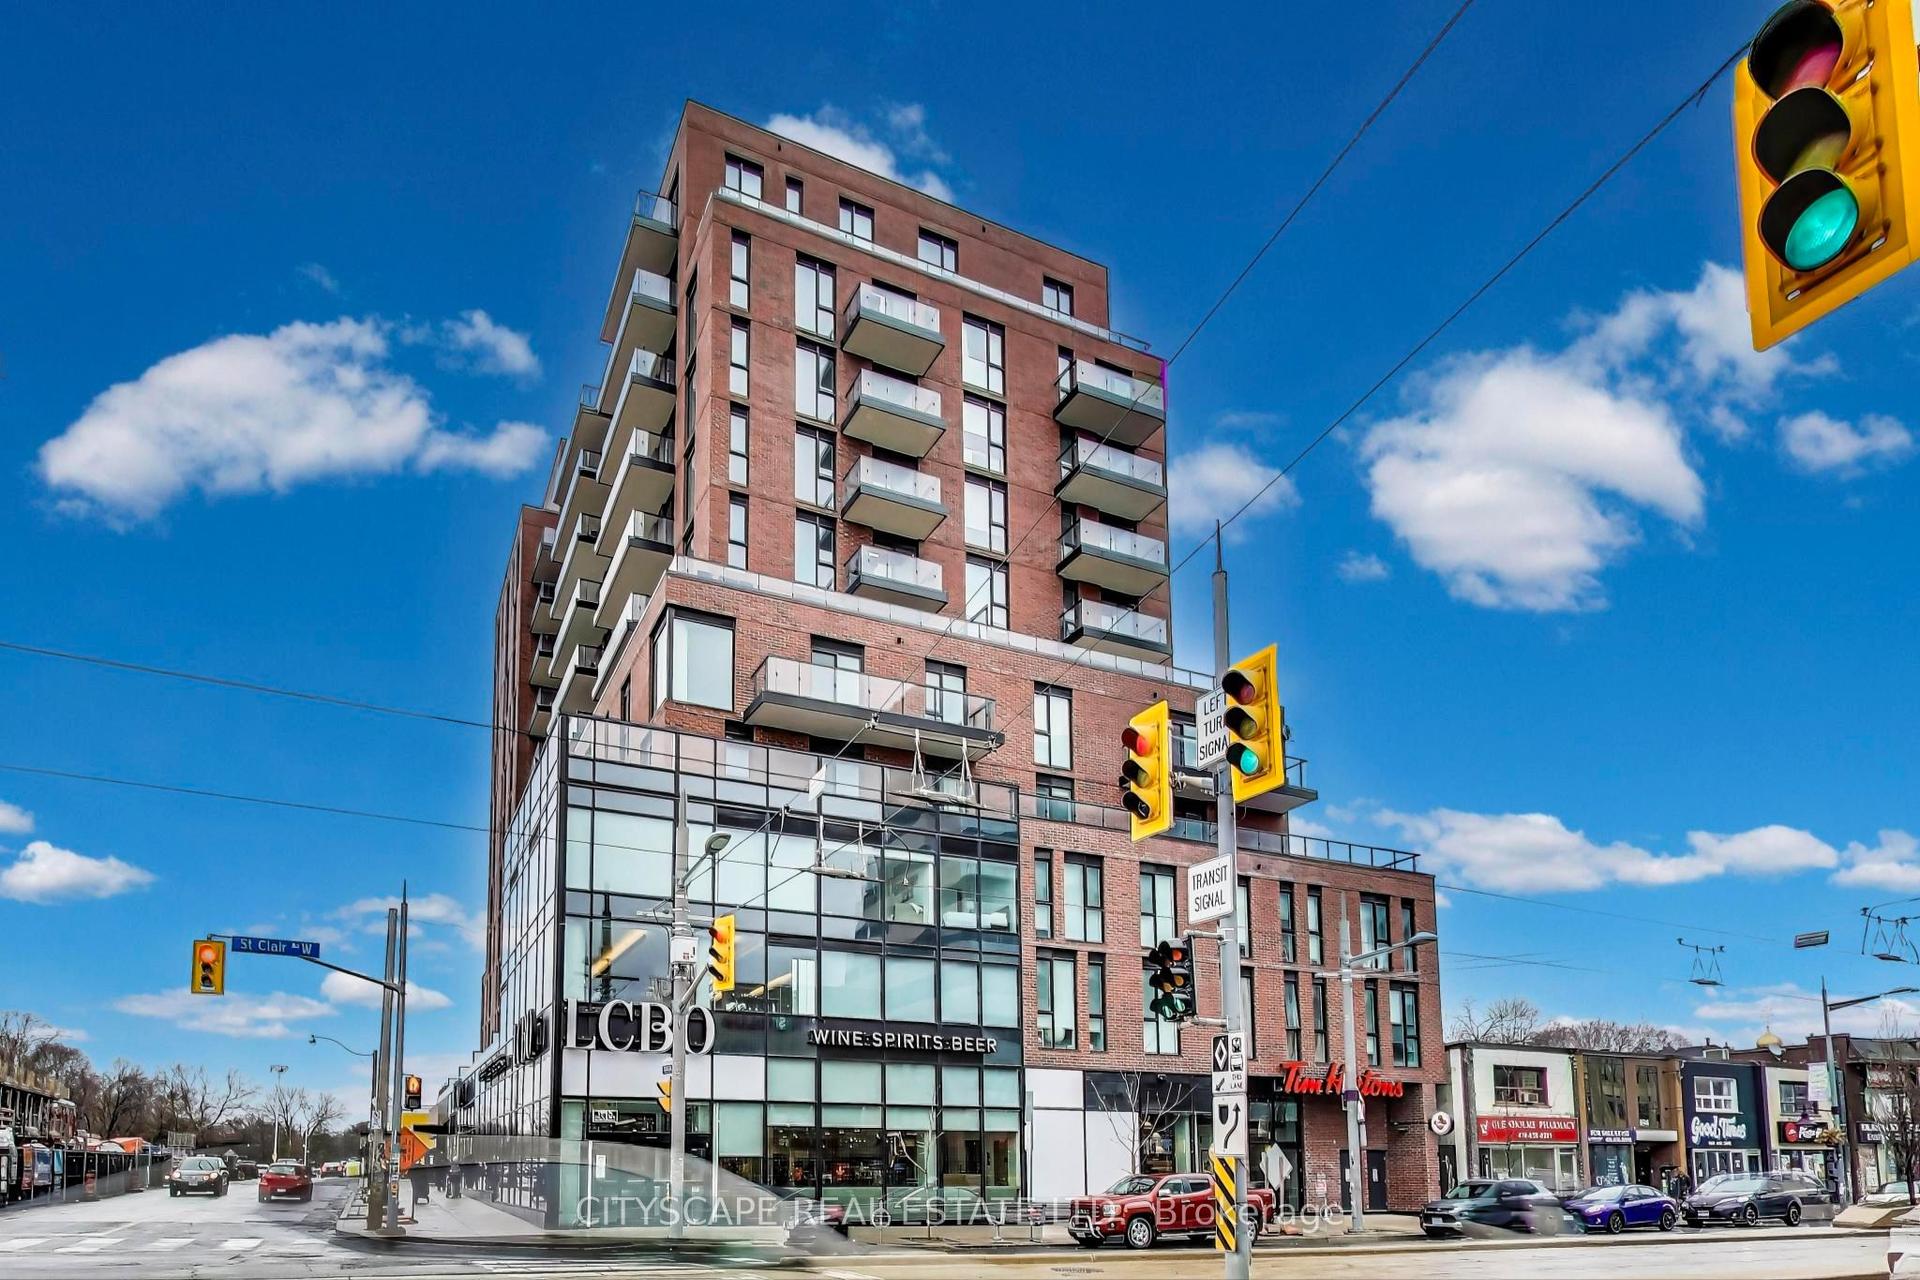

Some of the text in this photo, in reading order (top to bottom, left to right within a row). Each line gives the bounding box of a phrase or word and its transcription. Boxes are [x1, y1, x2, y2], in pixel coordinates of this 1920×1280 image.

[1204, 715, 1226, 737] TUR
[1192, 864, 1228, 891] TRANSIT
[1194, 889, 1226, 912] SIGNAL
[240, 938, 252, 950] St
[258, 940, 286, 953] Clair
[301, 943, 313, 955] W
[564, 999, 716, 1055] LCBO
[872, 1032, 943, 1051] SPIRITS
[952, 1036, 997, 1053] BEER
[1280, 1060, 1323, 1096] Tim
[1691, 1114, 1721, 1146] Good
